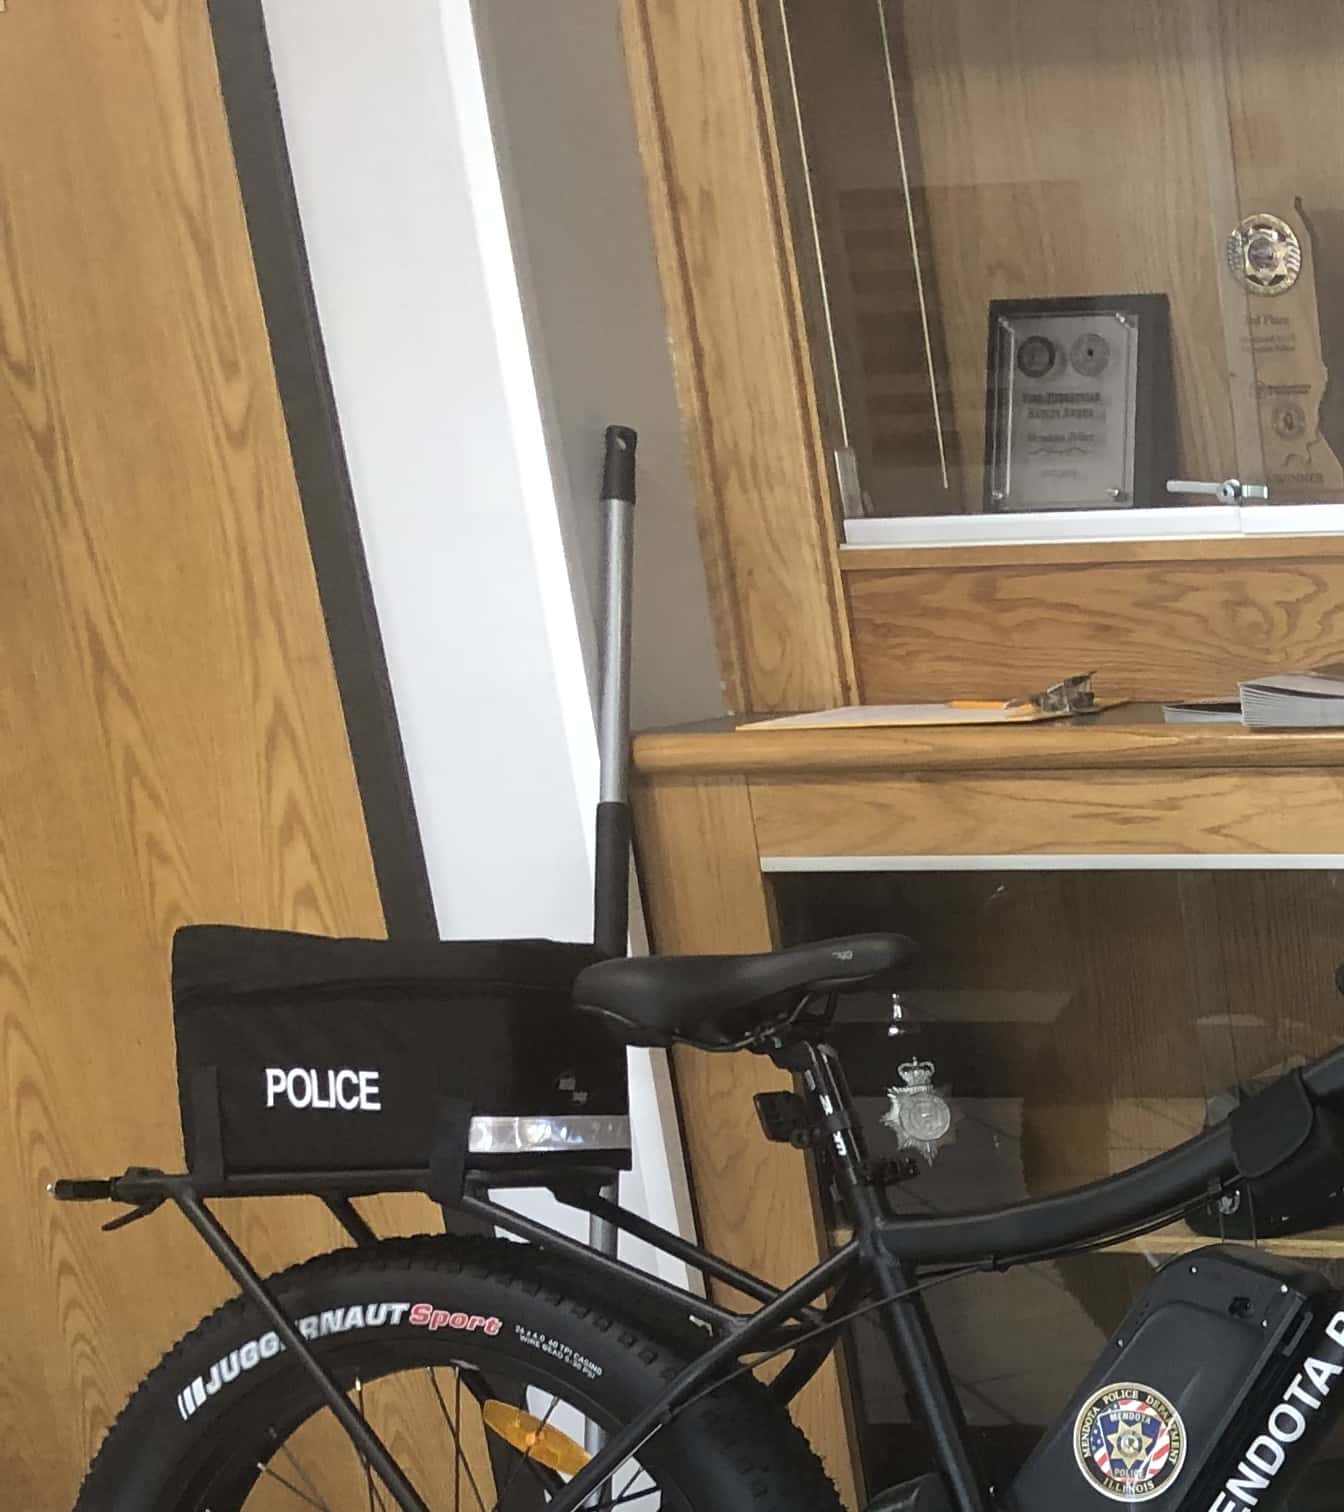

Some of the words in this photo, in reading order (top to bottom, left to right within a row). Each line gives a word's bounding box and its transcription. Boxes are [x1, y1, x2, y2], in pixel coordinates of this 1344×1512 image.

[264, 1067, 382, 1111] POLICE
[205, 1302, 411, 1395] JUGGRNAUT
[408, 1303, 503, 1337] Sport
[1080, 1405, 1101, 1459] MENDOTA
[1101, 1388, 1140, 1406] POLICE
[1109, 1411, 1152, 1425] MENDOTA
[1102, 1477, 1156, 1496] ILLINOIS
